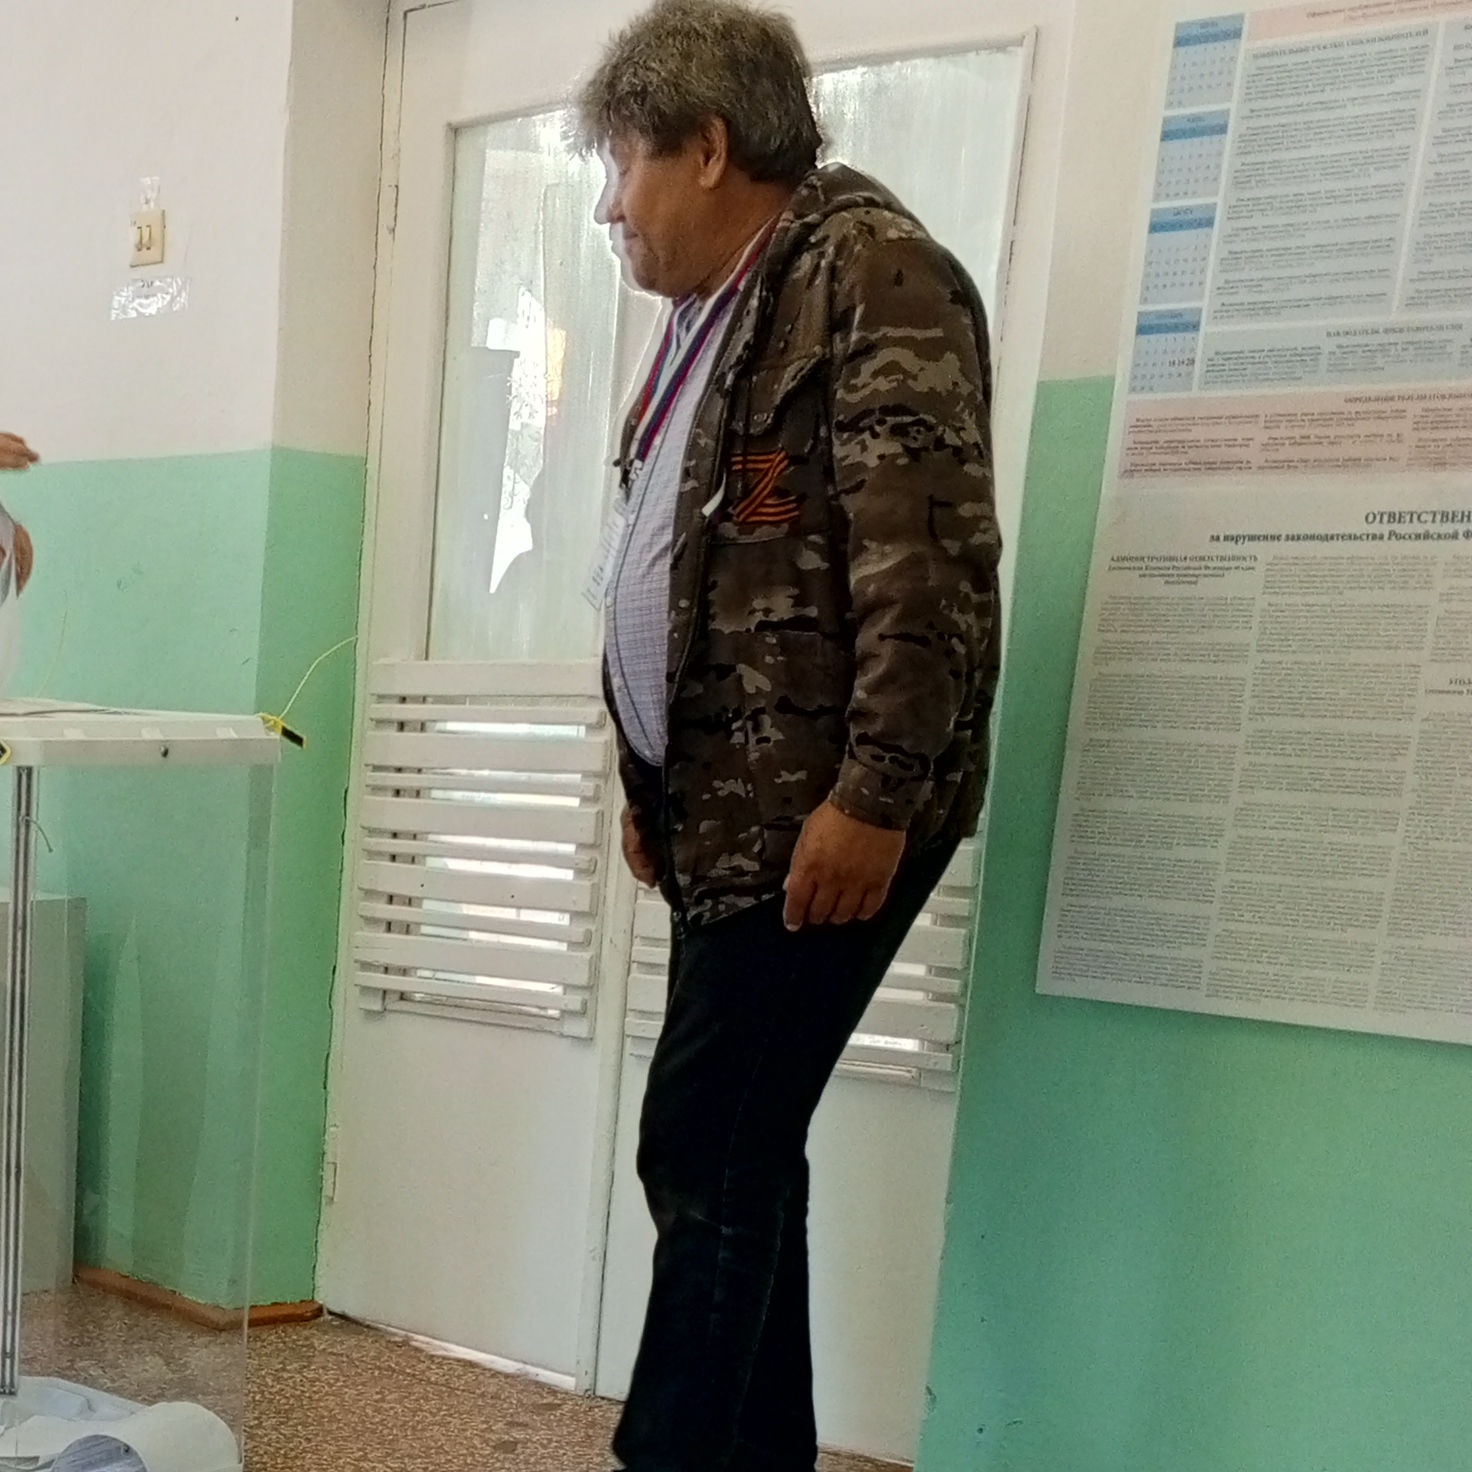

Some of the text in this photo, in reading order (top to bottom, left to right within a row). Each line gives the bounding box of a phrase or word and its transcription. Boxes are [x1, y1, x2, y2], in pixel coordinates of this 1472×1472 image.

[1364, 510, 1472, 525] ОТВЕТСТВЕН
[1209, 534, 1220, 543] за
[1223, 533, 1282, 545] нарушение
[1284, 531, 1384, 543] законодательства
[1387, 529, 1459, 542] Российской
